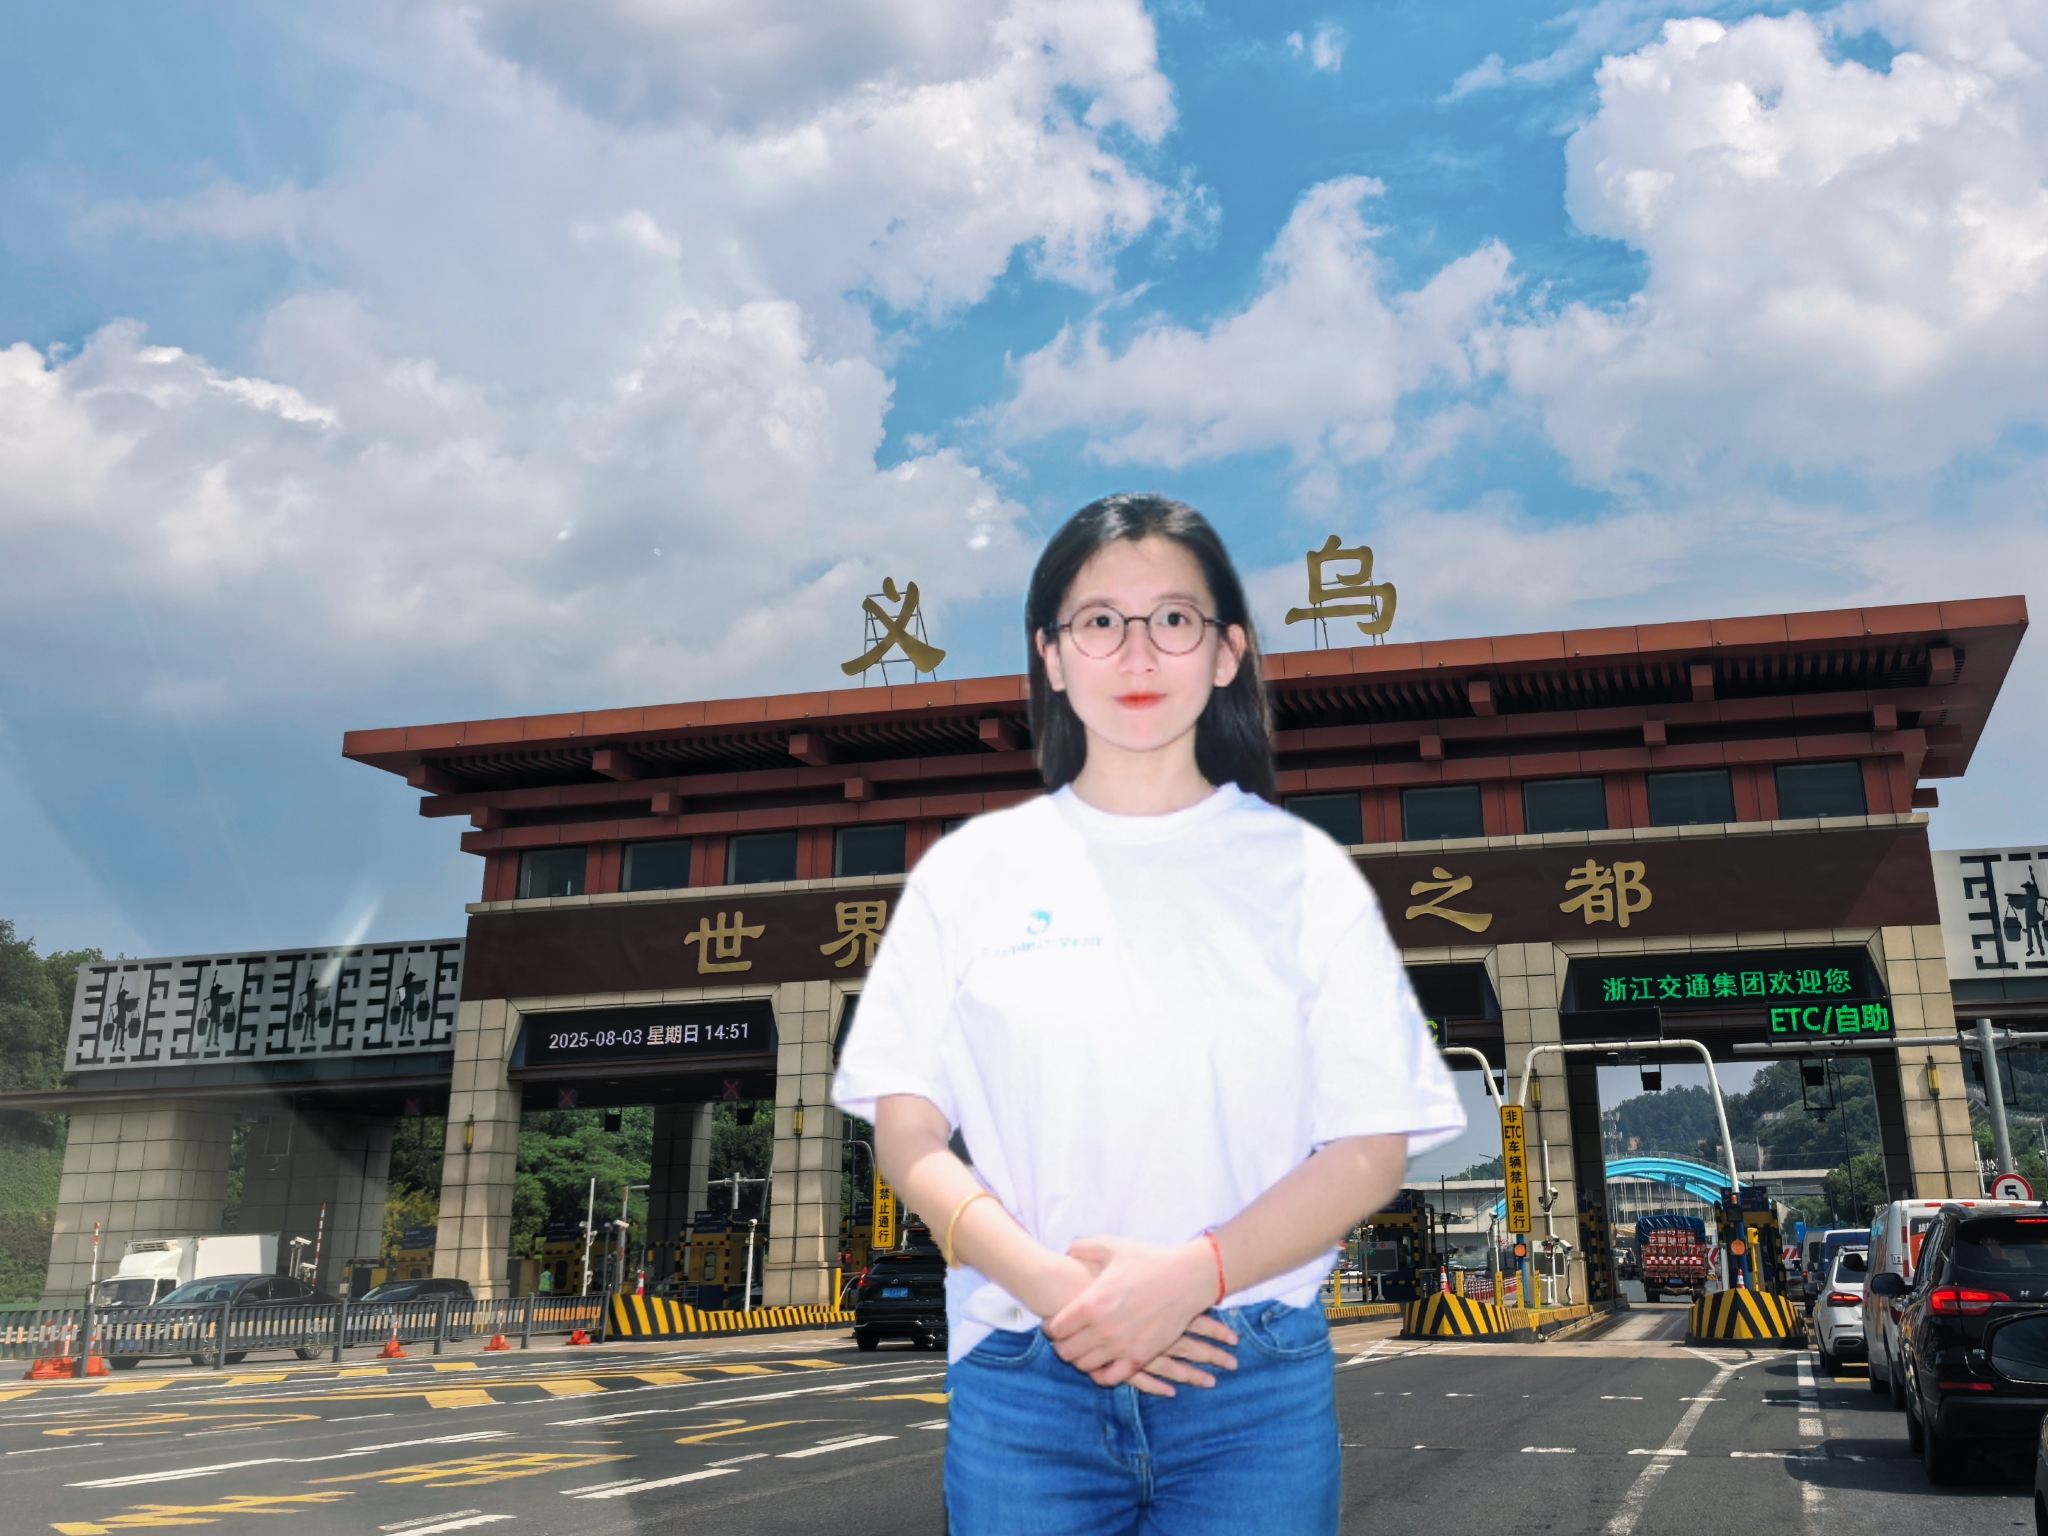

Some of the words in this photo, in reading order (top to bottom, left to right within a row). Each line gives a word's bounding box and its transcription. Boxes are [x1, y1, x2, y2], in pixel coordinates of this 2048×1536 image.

[1602, 968, 1852, 1001] 浙江交通集团欢迎您
[1770, 1003, 1890, 1035] ETC/自助
[549, 1029, 643, 1049] 2025-08-03
[647, 1025, 699, 1046] 星期日
[705, 1022, 749, 1041] 14:51
